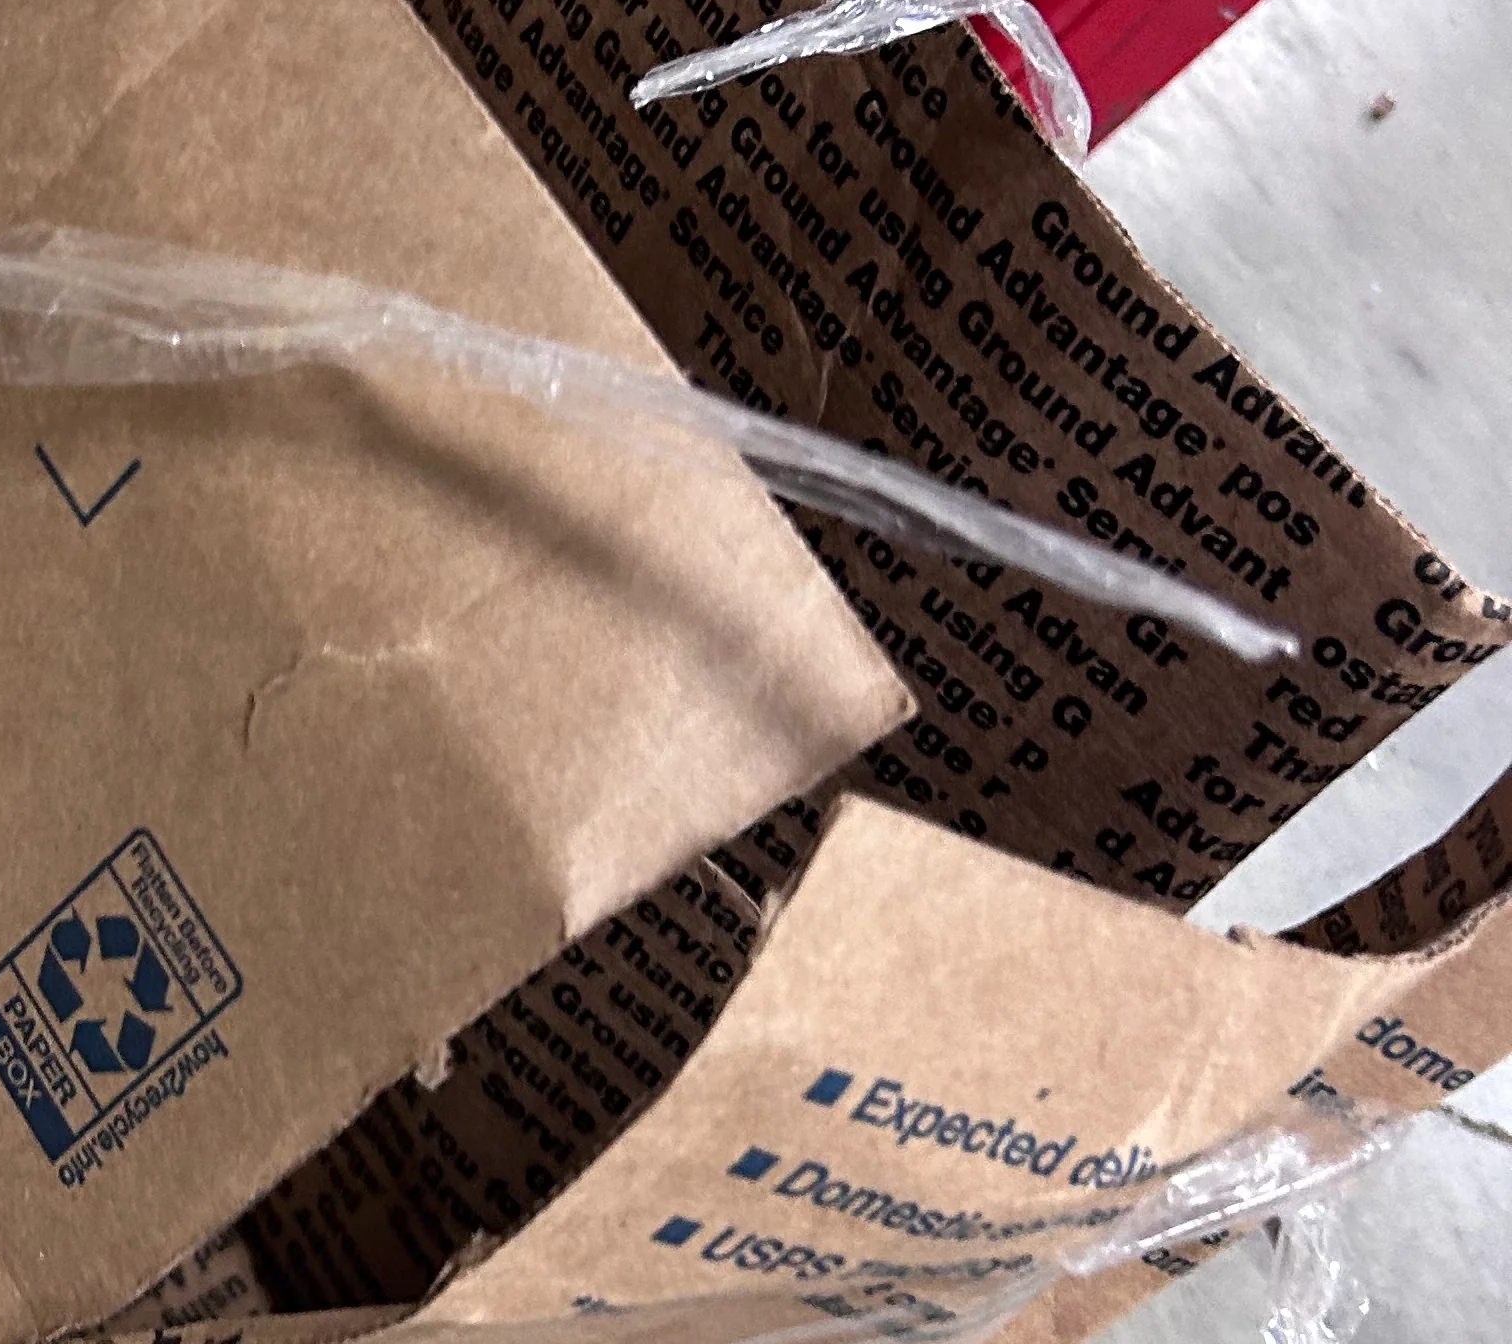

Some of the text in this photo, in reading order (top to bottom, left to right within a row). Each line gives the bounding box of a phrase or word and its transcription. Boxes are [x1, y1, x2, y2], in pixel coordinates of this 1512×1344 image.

[515, 88, 635, 246] required
[731, 116, 853, 266] Ground
[669, 206, 786, 355] Service
[854, 89, 985, 244] Ground
[1217, 462, 1321, 547] pos
[1029, 201, 1199, 363] Ground
[806, 120, 861, 191] for
[843, 186, 954, 310] using
[957, 299, 1118, 460] Ground
[1111, 452, 1292, 604] Advant
[919, 586, 1045, 703] using
[1001, 587, 1148, 716] Advan
[1187, 751, 1266, 821] for
[604, 917, 715, 1030] Thank
[3, 994, 77, 1108] PAPER
[849, 1077, 1079, 1177] Expected
[699, 1225, 845, 1282] USPS
